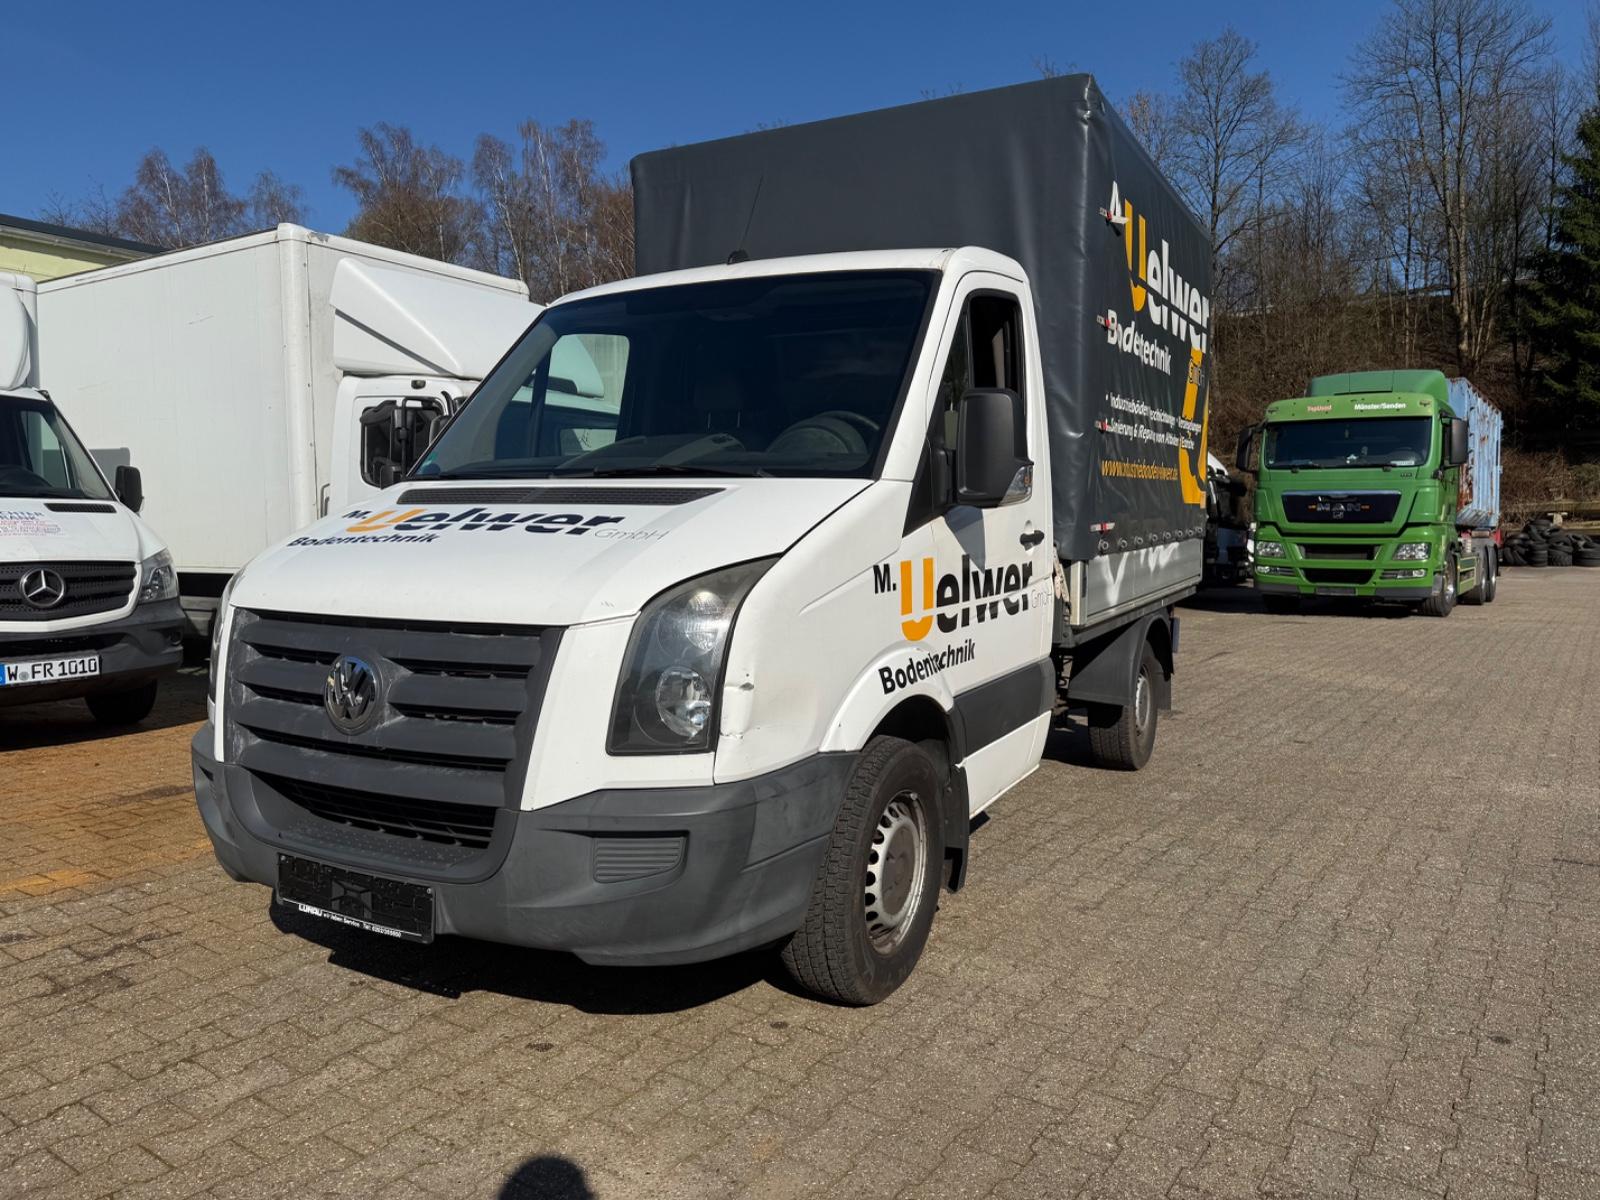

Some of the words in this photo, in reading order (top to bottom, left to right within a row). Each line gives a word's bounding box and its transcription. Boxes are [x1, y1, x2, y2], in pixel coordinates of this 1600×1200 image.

[342, 510, 371, 520] M.
[346, 508, 625, 535] Uelwer
[286, 533, 438, 547] Bodentechnik
[594, 528, 671, 541] GmbH
[873, 563, 897, 594] M.
[900, 554, 1033, 642] Uelwer
[7, 665, 18, 681] W
[31, 662, 54, 679] FR
[58, 658, 97, 676] 1010
